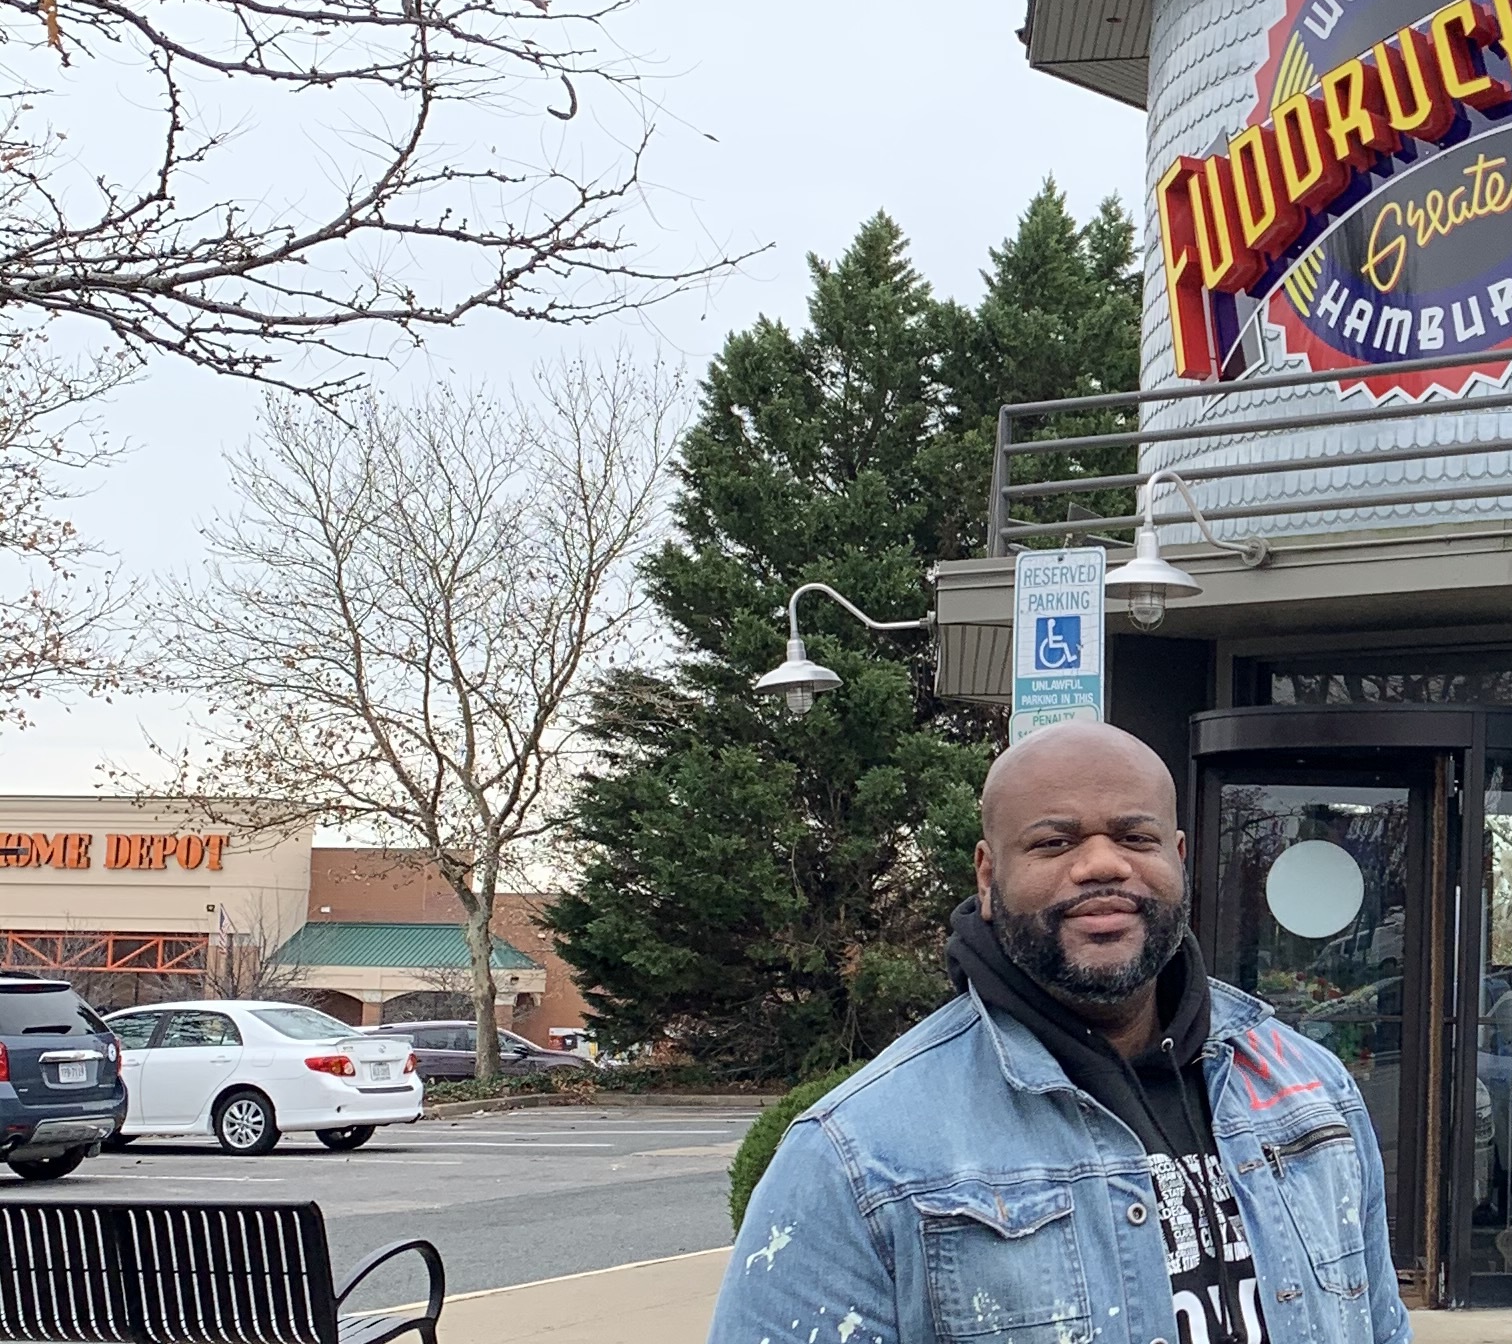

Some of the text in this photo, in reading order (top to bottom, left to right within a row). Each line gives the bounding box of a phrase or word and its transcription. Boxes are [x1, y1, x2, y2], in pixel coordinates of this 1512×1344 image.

[1023, 564, 1097, 587] RESERVED
[1028, 590, 1090, 612] PARKING
[1031, 679, 1083, 692] UNLAWFUL
[1021, 692, 1094, 706] PARKING IN THIS
[103, 833, 230, 871] DEPOT
